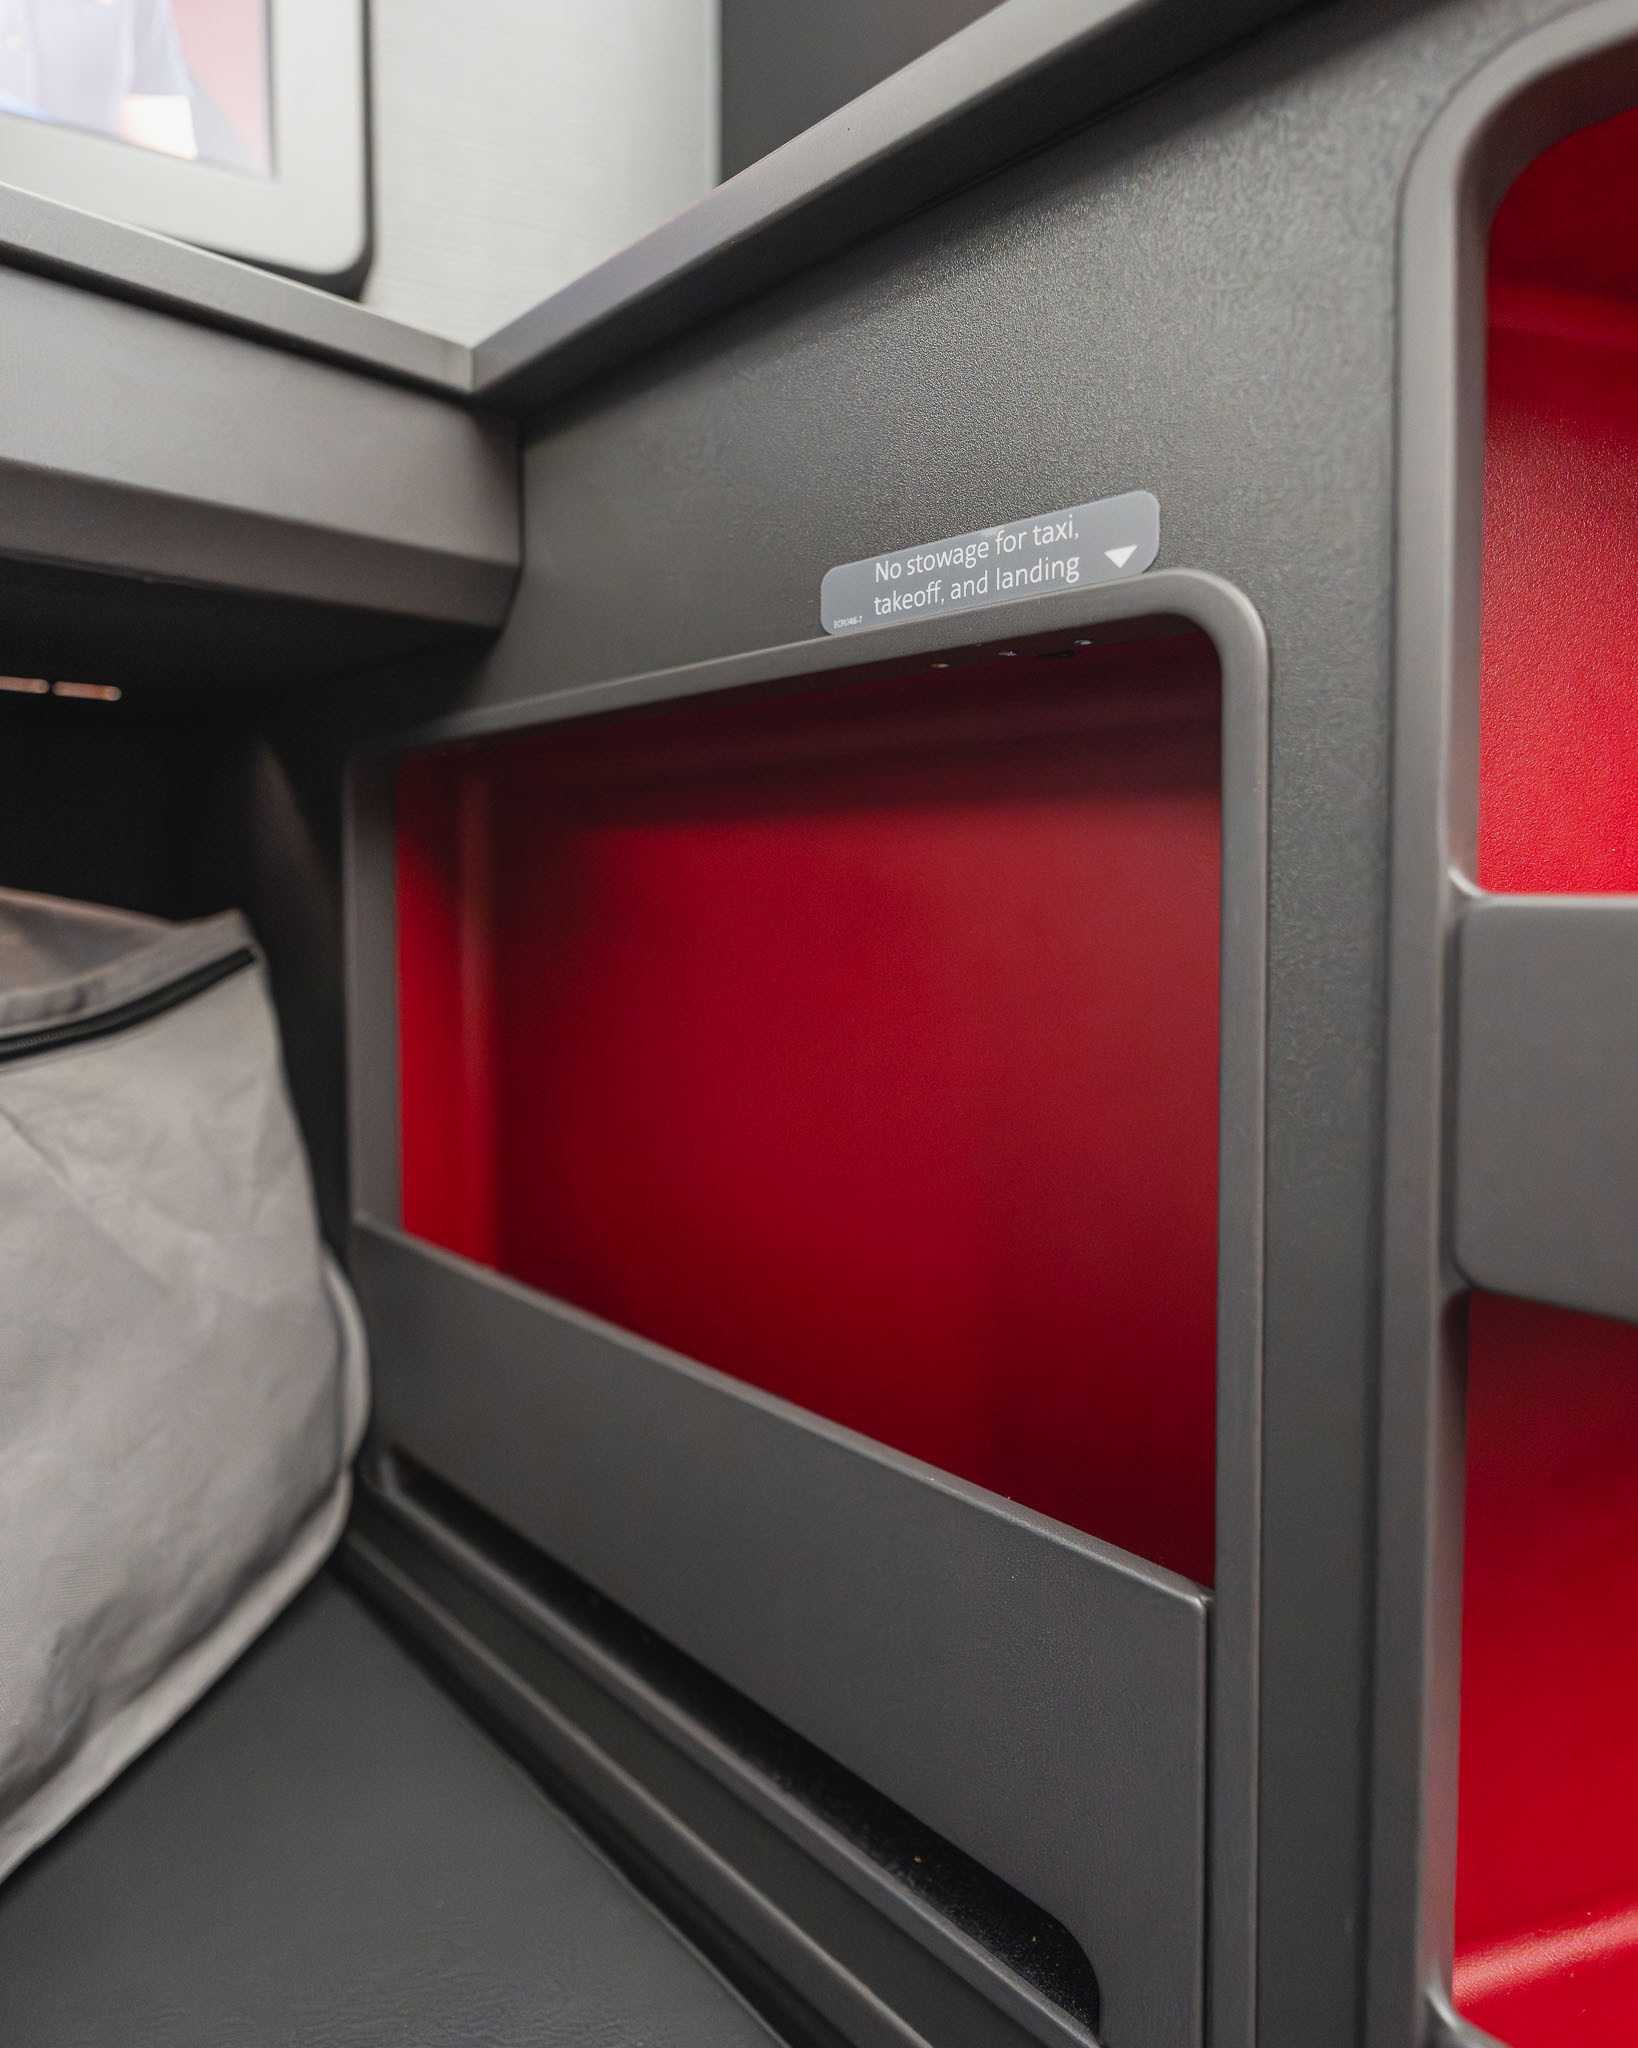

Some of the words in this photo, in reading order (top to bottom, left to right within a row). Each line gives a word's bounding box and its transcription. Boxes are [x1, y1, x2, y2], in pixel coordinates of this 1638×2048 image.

[875, 560, 902, 583] No
[906, 541, 989, 577] stowage
[995, 530, 1028, 555] for
[1032, 514, 1079, 546] taxi,
[873, 579, 945, 616] takeoff,
[950, 569, 988, 600] and
[997, 556, 1080, 591] landing
